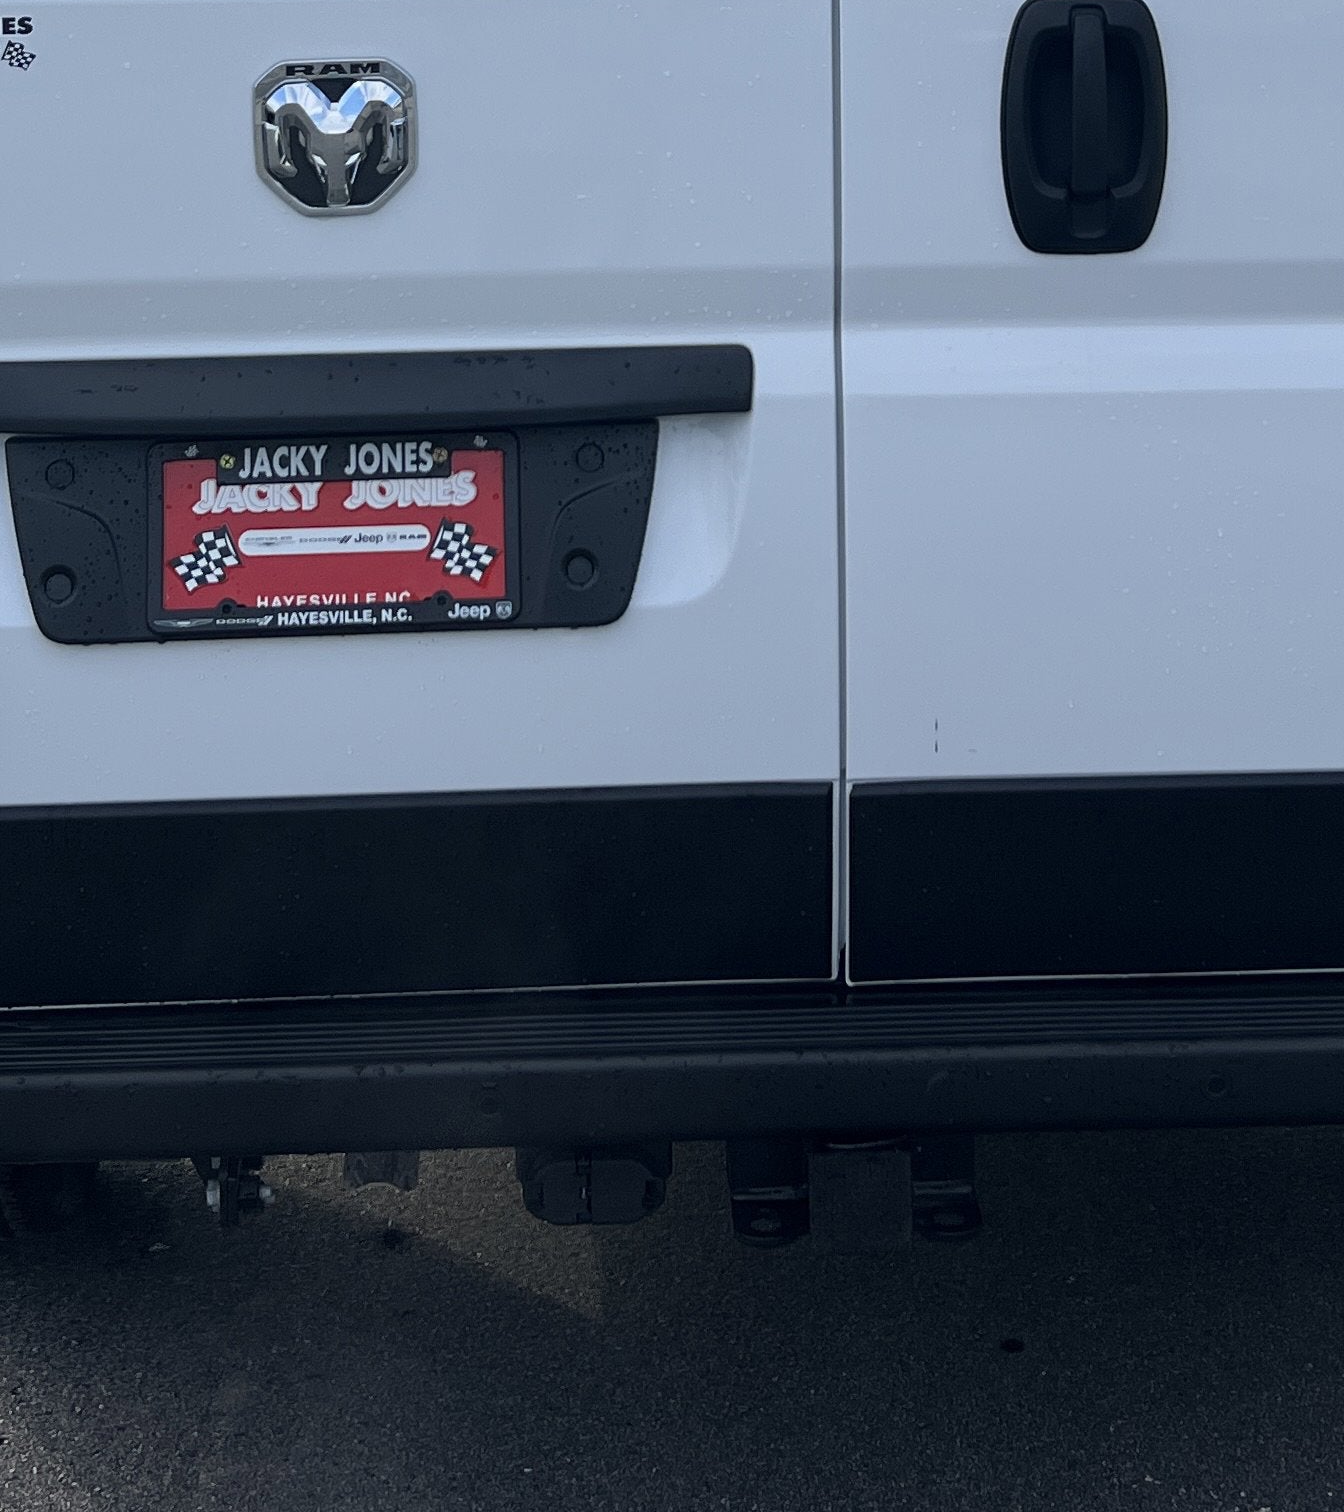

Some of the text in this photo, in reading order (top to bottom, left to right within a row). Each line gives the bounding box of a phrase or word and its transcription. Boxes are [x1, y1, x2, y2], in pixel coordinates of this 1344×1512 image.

[286, 62, 380, 76] RAM
[238, 441, 433, 479] JACKY JONES
[192, 469, 477, 515] JACKY JONES
[354, 532, 383, 544] Jeep
[277, 608, 413, 626] HAYESVILLE, N.C.
[448, 603, 491, 620] Jeep
